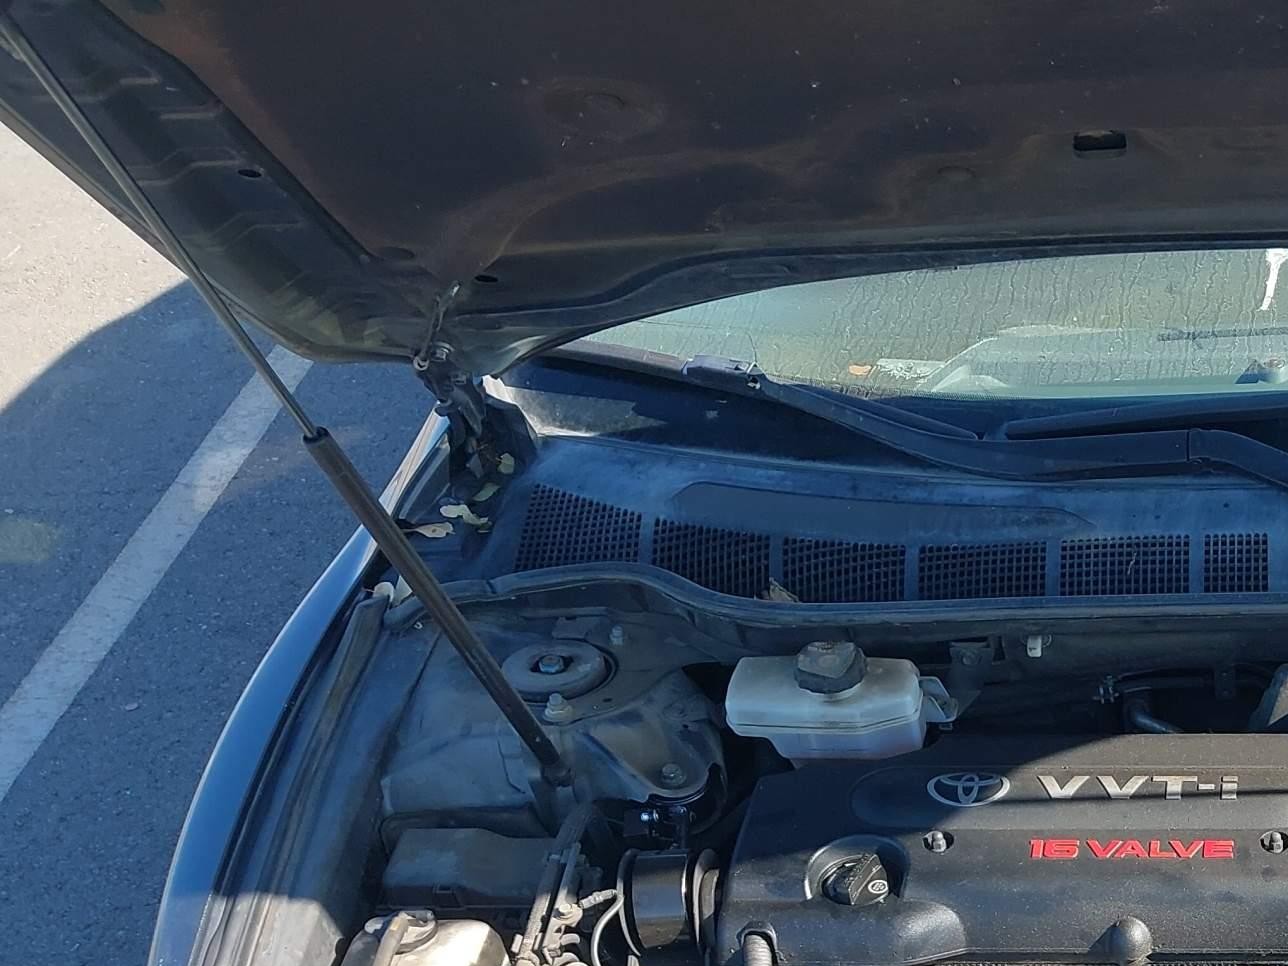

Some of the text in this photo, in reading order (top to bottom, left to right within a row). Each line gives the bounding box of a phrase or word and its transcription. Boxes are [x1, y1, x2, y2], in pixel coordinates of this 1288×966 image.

[1037, 775, 1239, 800] VVT-i
[1029, 839, 1235, 859] 16 VALVE
